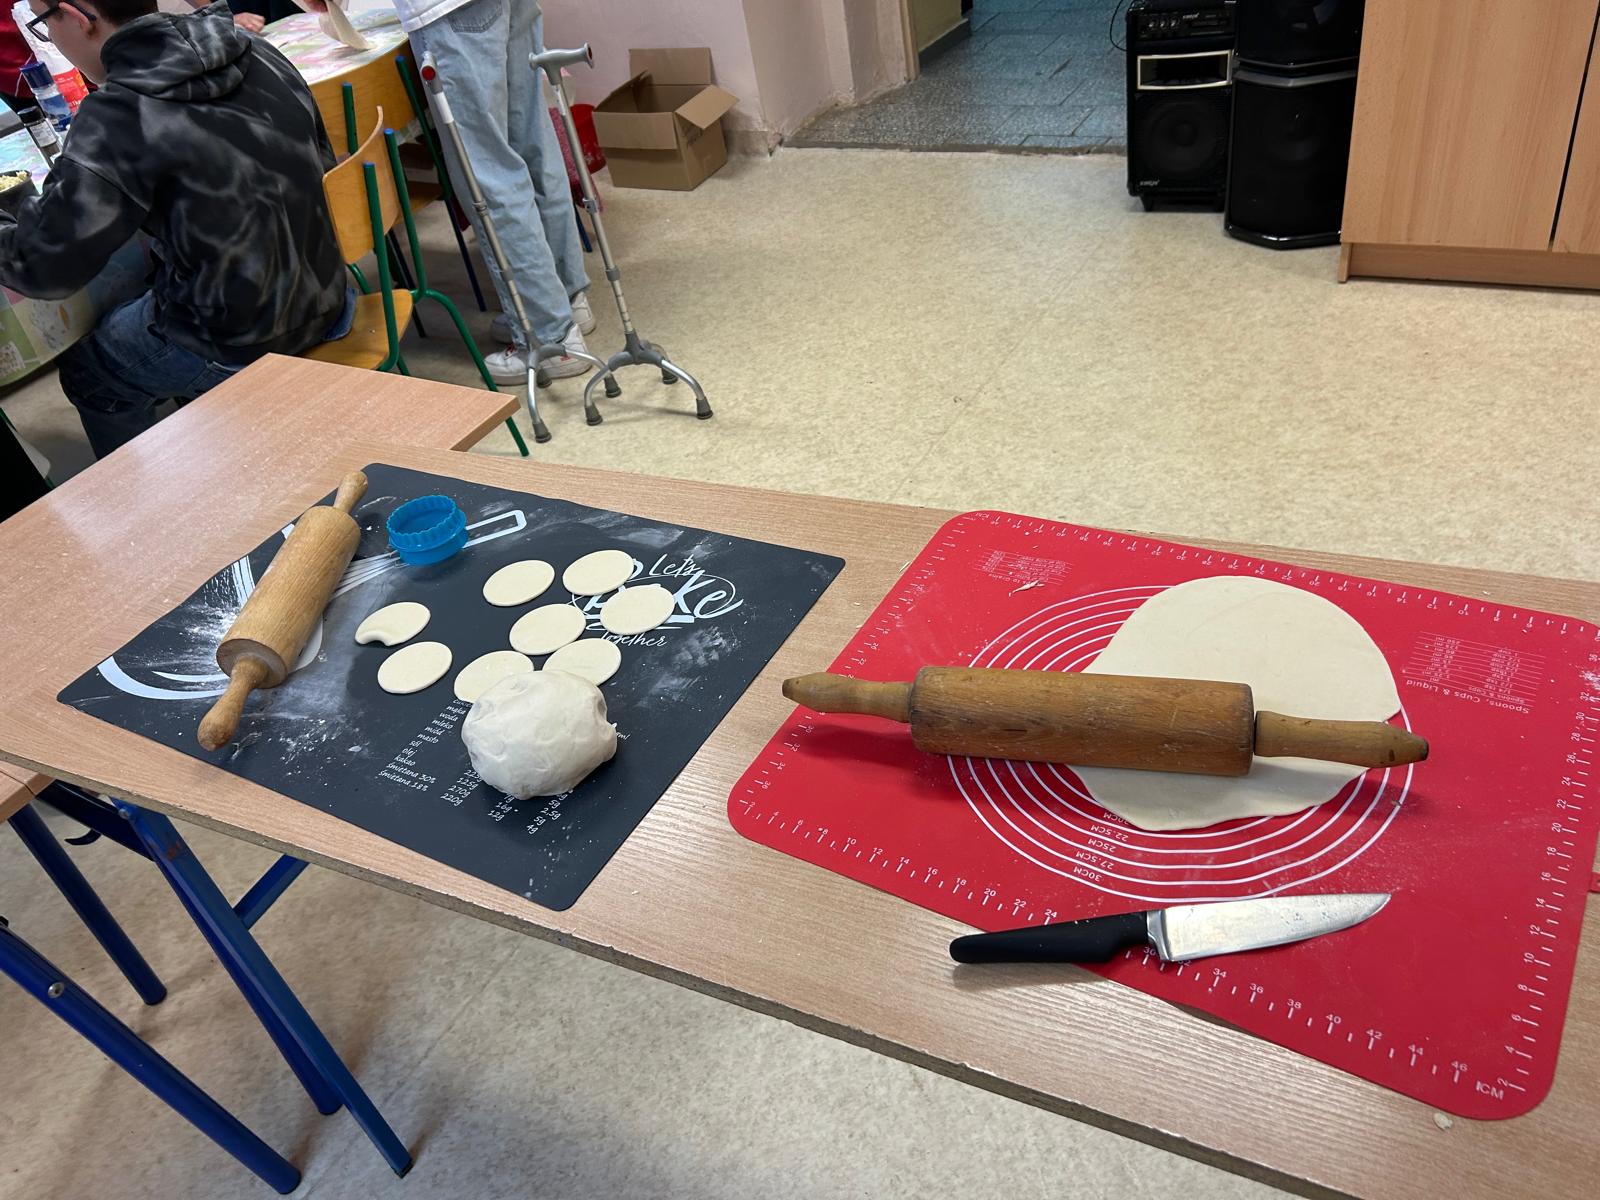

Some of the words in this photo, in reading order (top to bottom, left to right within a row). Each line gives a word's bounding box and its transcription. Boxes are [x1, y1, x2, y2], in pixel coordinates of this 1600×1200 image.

[648, 553, 701, 578] Let's
[1406, 679, 1438, 692] Liquid
[1442, 687, 1450, 695] &
[1454, 690, 1480, 703] Cups
[1486, 698, 1530, 714] Spoons,
[439, 712, 459, 722] woda
[1575, 711, 1585, 721] 30
[431, 719, 454, 730] mleko
[393, 754, 416, 767] kakao
[456, 777, 479, 790] 125g
[1561, 776, 1572, 787] 24
[447, 784, 471, 799] 270g
[440, 792, 463, 807] 220g
[1556, 798, 1567, 809] 22
[1090, 824, 1129, 842] 22.5CM
[1551, 822, 1562, 833] 20
[1087, 838, 1117, 853] 25CM
[1546, 846, 1557, 856] 18
[1075, 851, 1115, 870] 27.5CM
[847, 837, 857, 845] 10
[872, 847, 883, 855] 12
[899, 856, 910, 865] 14
[927, 867, 938, 875] 16
[955, 877, 967, 886] 18
[983, 888, 997, 897] 20
[1013, 898, 1027, 908] 22
[1044, 908, 1057, 918] 24
[1073, 865, 1102, 882] 30CM
[1541, 871, 1551, 881] 16
[1535, 897, 1546, 908] 14
[1529, 924, 1541, 936] 12
[1523, 952, 1535, 964] 10
[1517, 983, 1528, 991] 8
[1143, 946, 1156, 956] 30
[1212, 967, 1227, 978] 34
[1249, 982, 1264, 994] 36
[1287, 998, 1302, 1010] 38
[1325, 1013, 1342, 1024] 40
[1366, 1028, 1383, 1040] 42
[1407, 1044, 1424, 1056] 44
[1450, 1061, 1468, 1072] 46
[1511, 1013, 1522, 1022] 6
[1504, 1045, 1515, 1054] 4
[1497, 1077, 1509, 1087] 2
